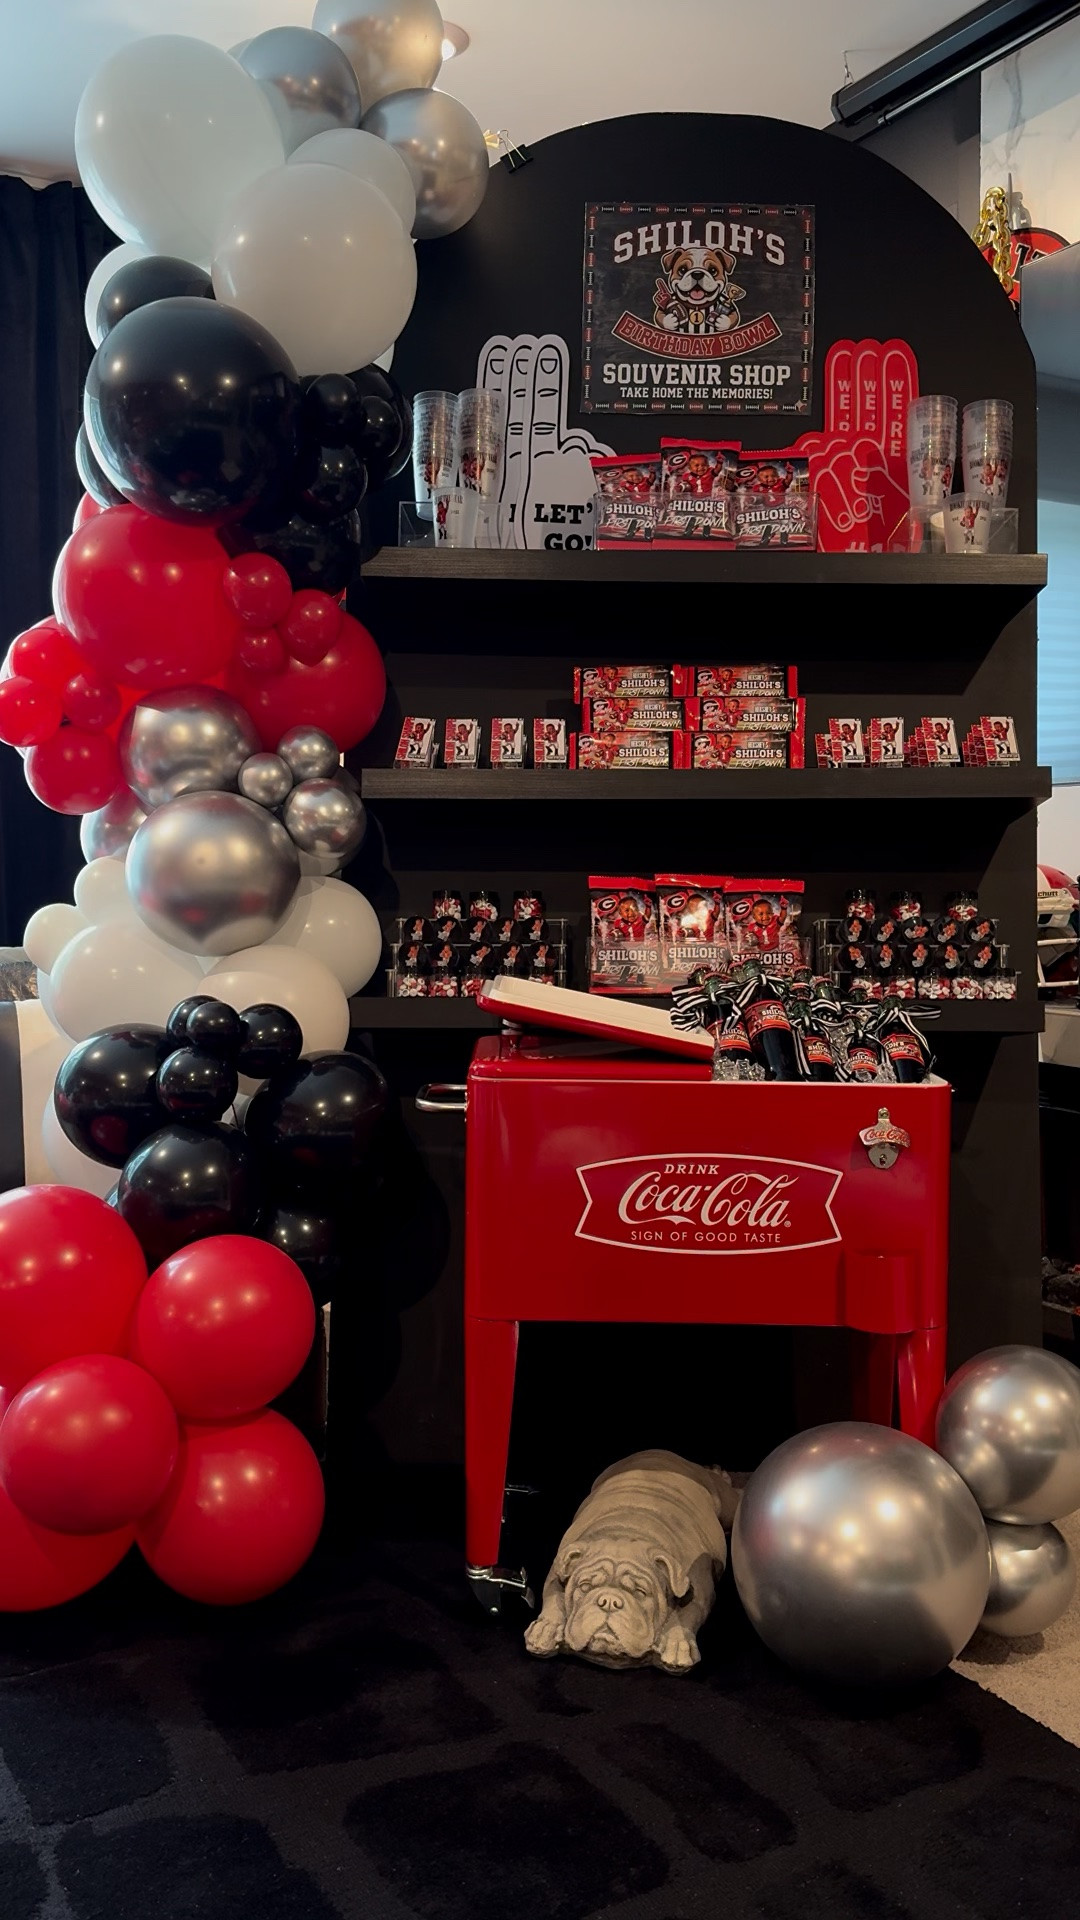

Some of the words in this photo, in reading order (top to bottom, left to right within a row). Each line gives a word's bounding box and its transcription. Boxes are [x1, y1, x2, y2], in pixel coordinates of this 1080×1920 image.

[614, 220, 786, 266] SHILOH'S
[619, 318, 715, 356] BIRTHDAY
[719, 319, 776, 353] BOWL
[603, 363, 722, 385] SOUVENIR
[729, 364, 791, 386] SHOP
[620, 386, 649, 398] TAKE
[652, 387, 683, 398] HOME
[686, 387, 709, 398] THE
[712, 388, 773, 400] MEMORIES!
[736, 507, 801, 525] SHILOH'S
[621, 679, 665, 688] SHILOH'S
[736, 681, 781, 689] SHILOH'S
[633, 711, 678, 719] SHILOH'S
[743, 713, 789, 722] SHILOH'S
[619, 748, 665, 757] SHILOH'S
[735, 749, 783, 758] SHILOH'S
[598, 950, 658, 961] SHILOH'S
[663, 1163, 721, 1176] DRINK
[631, 1230, 664, 1242] SIGN
[670, 1231, 688, 1242] OF
[694, 1232, 738, 1243] GOOD
[743, 1232, 781, 1244] TASTE
